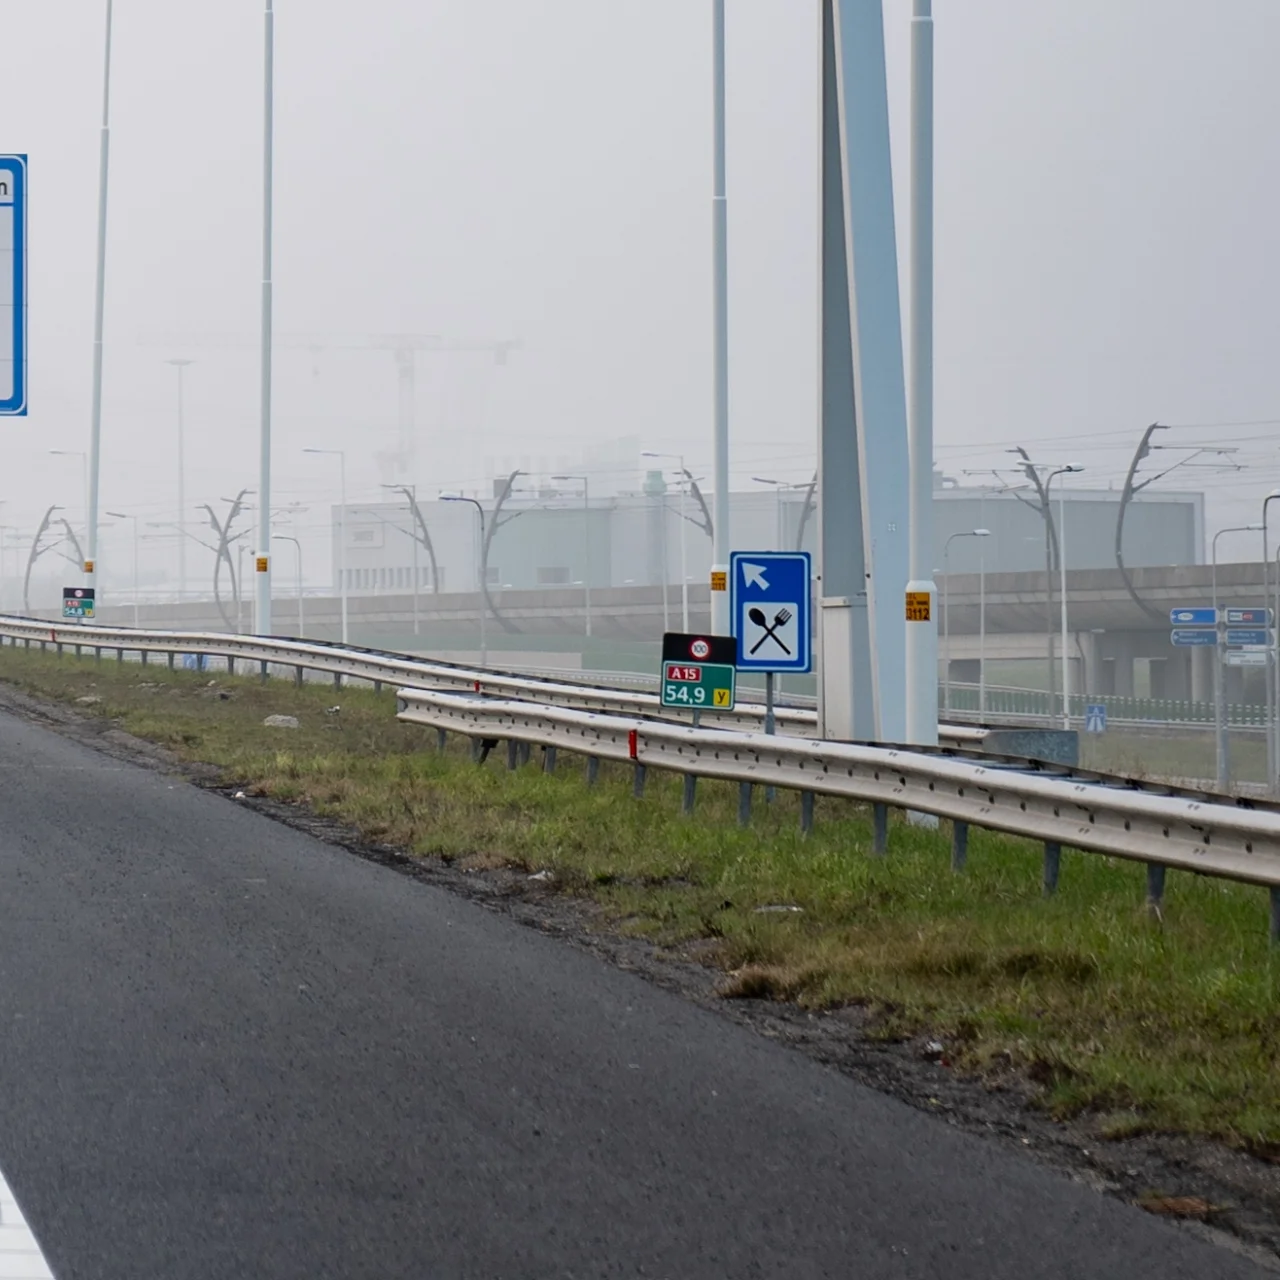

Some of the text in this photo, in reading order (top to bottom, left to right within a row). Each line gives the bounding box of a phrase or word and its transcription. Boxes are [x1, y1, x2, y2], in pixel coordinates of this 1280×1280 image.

[694, 644, 707, 653] 100
[665, 685, 726, 705] 54,9 y
